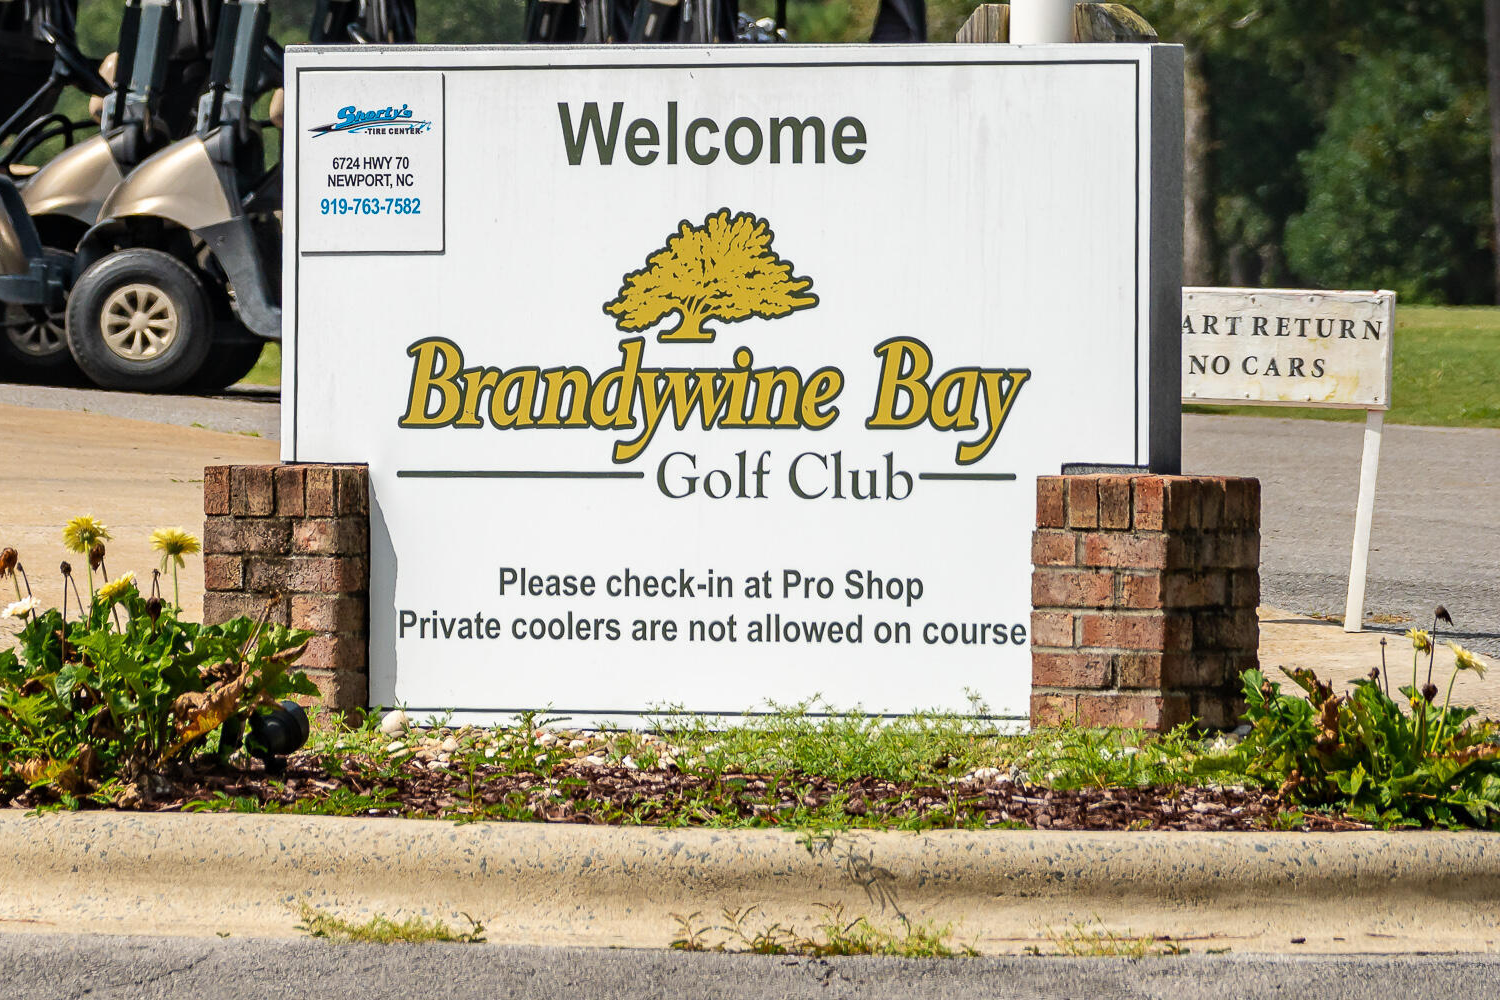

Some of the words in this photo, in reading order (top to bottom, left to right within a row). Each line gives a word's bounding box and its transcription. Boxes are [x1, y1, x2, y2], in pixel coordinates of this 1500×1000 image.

[557, 101, 868, 166] Welcome
[332, 157, 360, 170] 6724
[363, 157, 393, 170] HWY
[395, 157, 410, 170] 70
[327, 174, 393, 189] NEWPORT,
[396, 174, 414, 187] NC
[320, 198, 421, 215] 919-763-7582
[1251, 316, 1383, 341] RETURN
[1188, 355, 1230, 375] NO
[1242, 355, 1326, 378] CARS
[398, 336, 844, 463] Brandywine
[865, 336, 1032, 465] Bay
[656, 450, 771, 500] Golf
[788, 451, 914, 501] Club
[499, 567, 596, 597] Please
[606, 567, 733, 598] check-in
[744, 570, 772, 599] at
[783, 569, 834, 600] Pro
[844, 569, 924, 606] Shop
[399, 610, 501, 640] Private
[511, 610, 621, 641] coolers
[631, 619, 678, 642] are
[689, 614, 737, 643] not
[747, 613, 863, 644] allowed
[873, 621, 912, 644] on
[922, 622, 1028, 646] course
